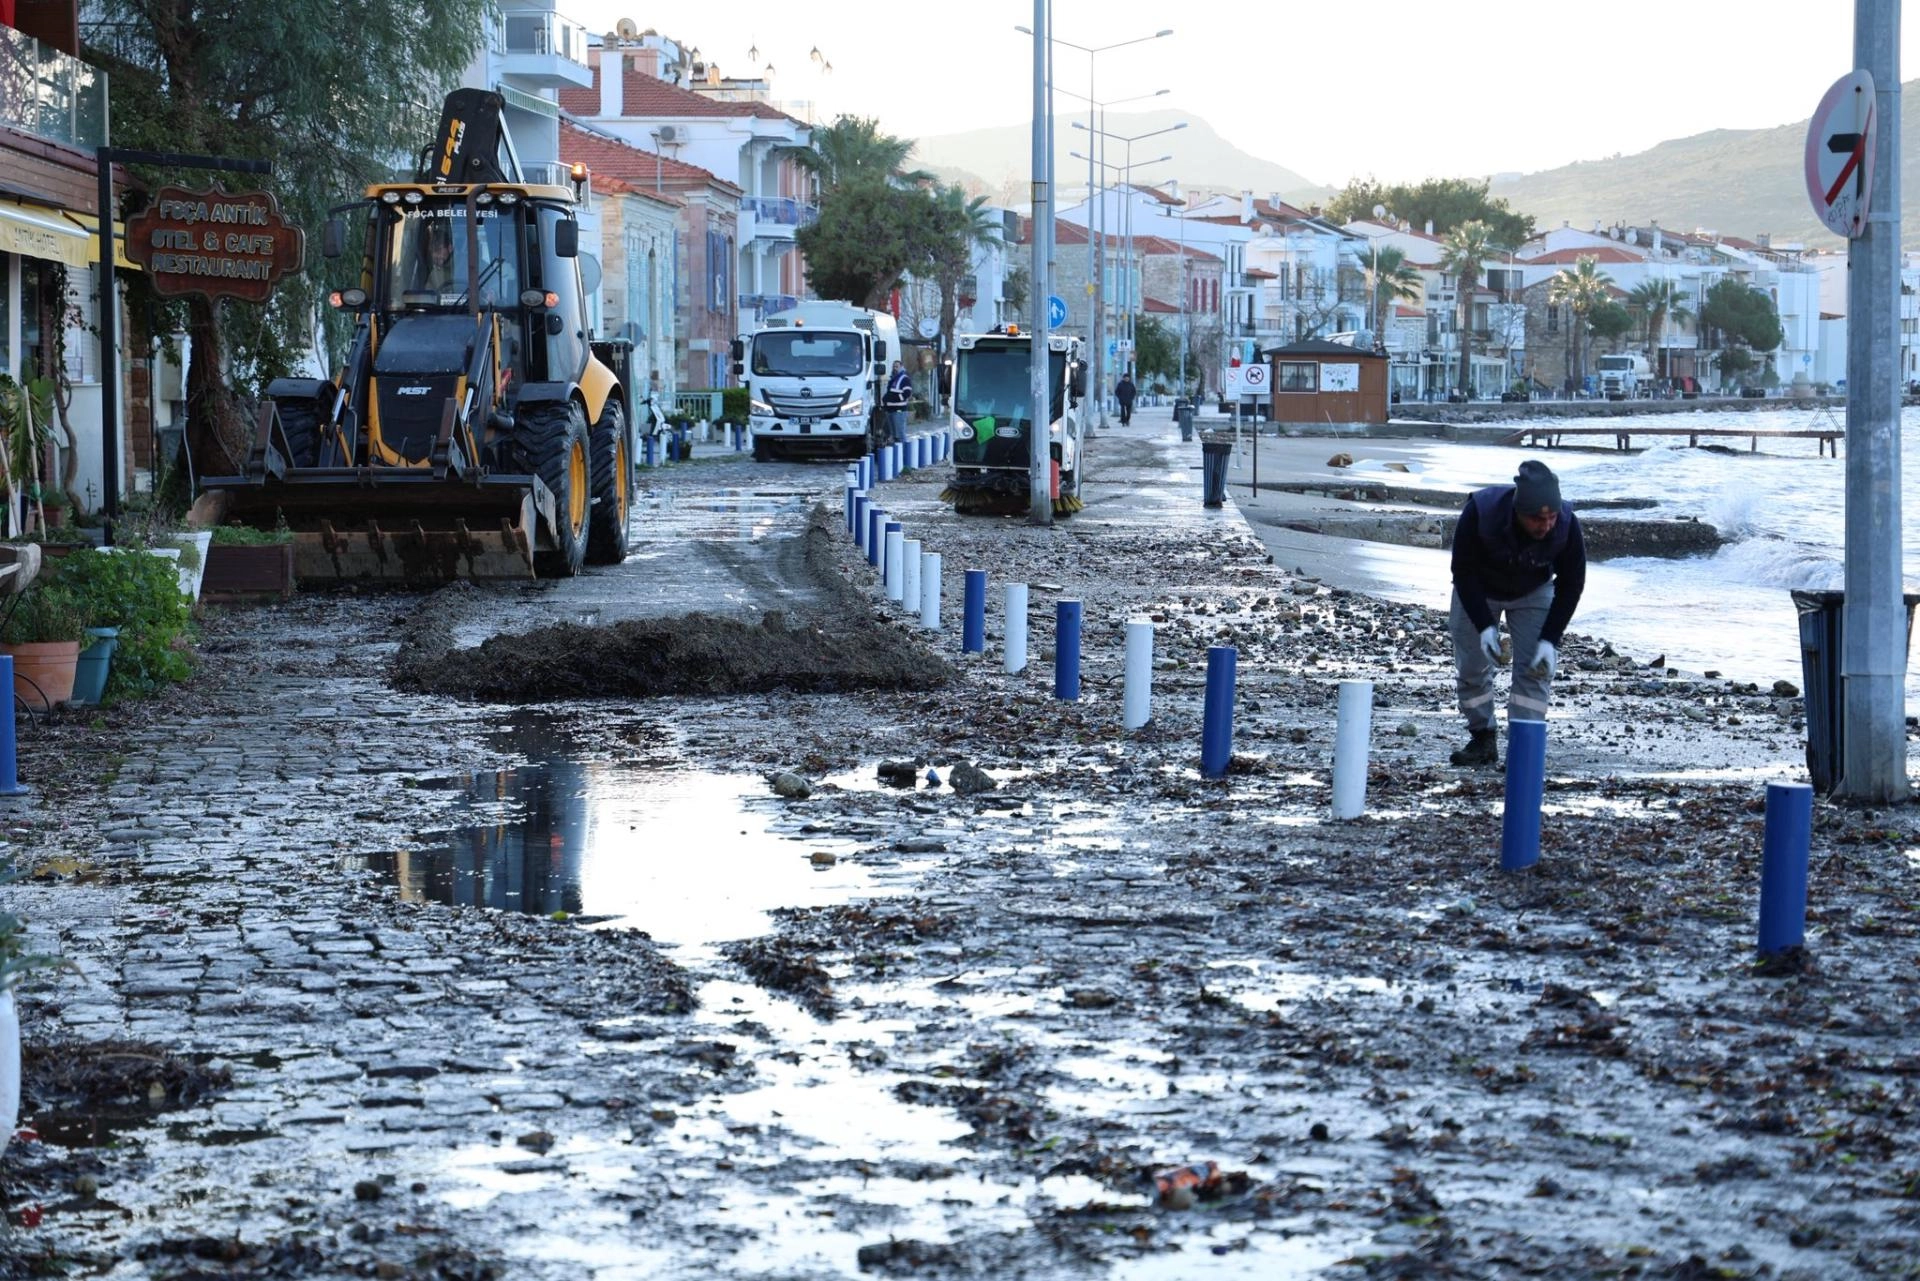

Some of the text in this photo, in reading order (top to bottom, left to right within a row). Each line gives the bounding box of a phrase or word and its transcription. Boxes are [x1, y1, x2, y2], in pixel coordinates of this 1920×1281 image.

[454, 120, 466, 154] PLUS
[160, 201, 269, 226] FOÇA ANTİK
[408, 209, 434, 220] FOÇA
[151, 228, 274, 255] OTEL & CAFE
[152, 253, 273, 280] RESTAURANT
[397, 386, 432, 395] MST
